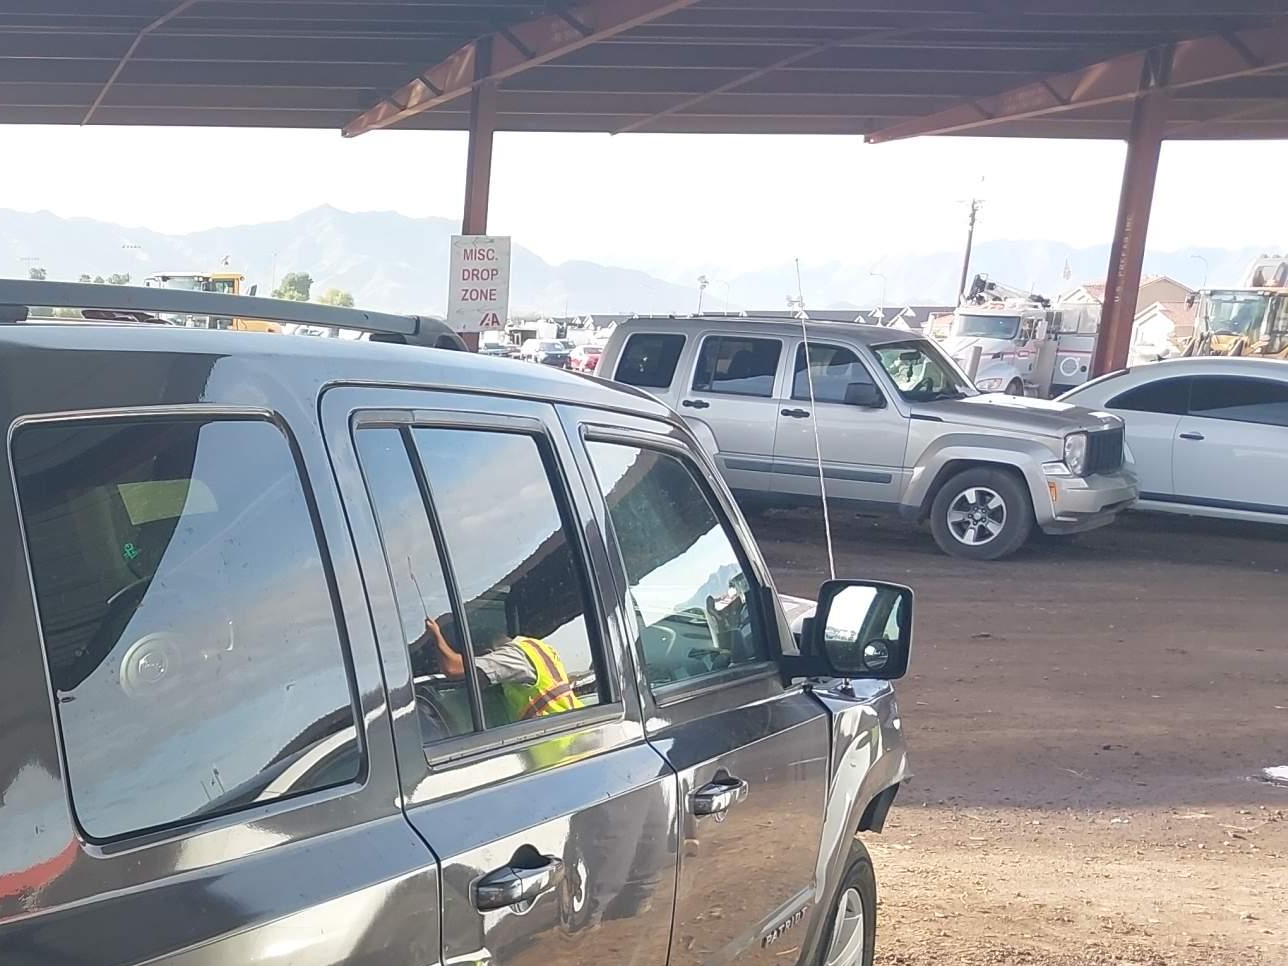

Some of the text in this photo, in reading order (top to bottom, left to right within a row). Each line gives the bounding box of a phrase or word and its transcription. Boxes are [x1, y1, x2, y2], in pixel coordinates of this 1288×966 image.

[463, 248, 499, 261] MISC.
[462, 268, 499, 281] DROP
[461, 288, 497, 302] ZONE
[765, 906, 808, 946] PATRIOT
